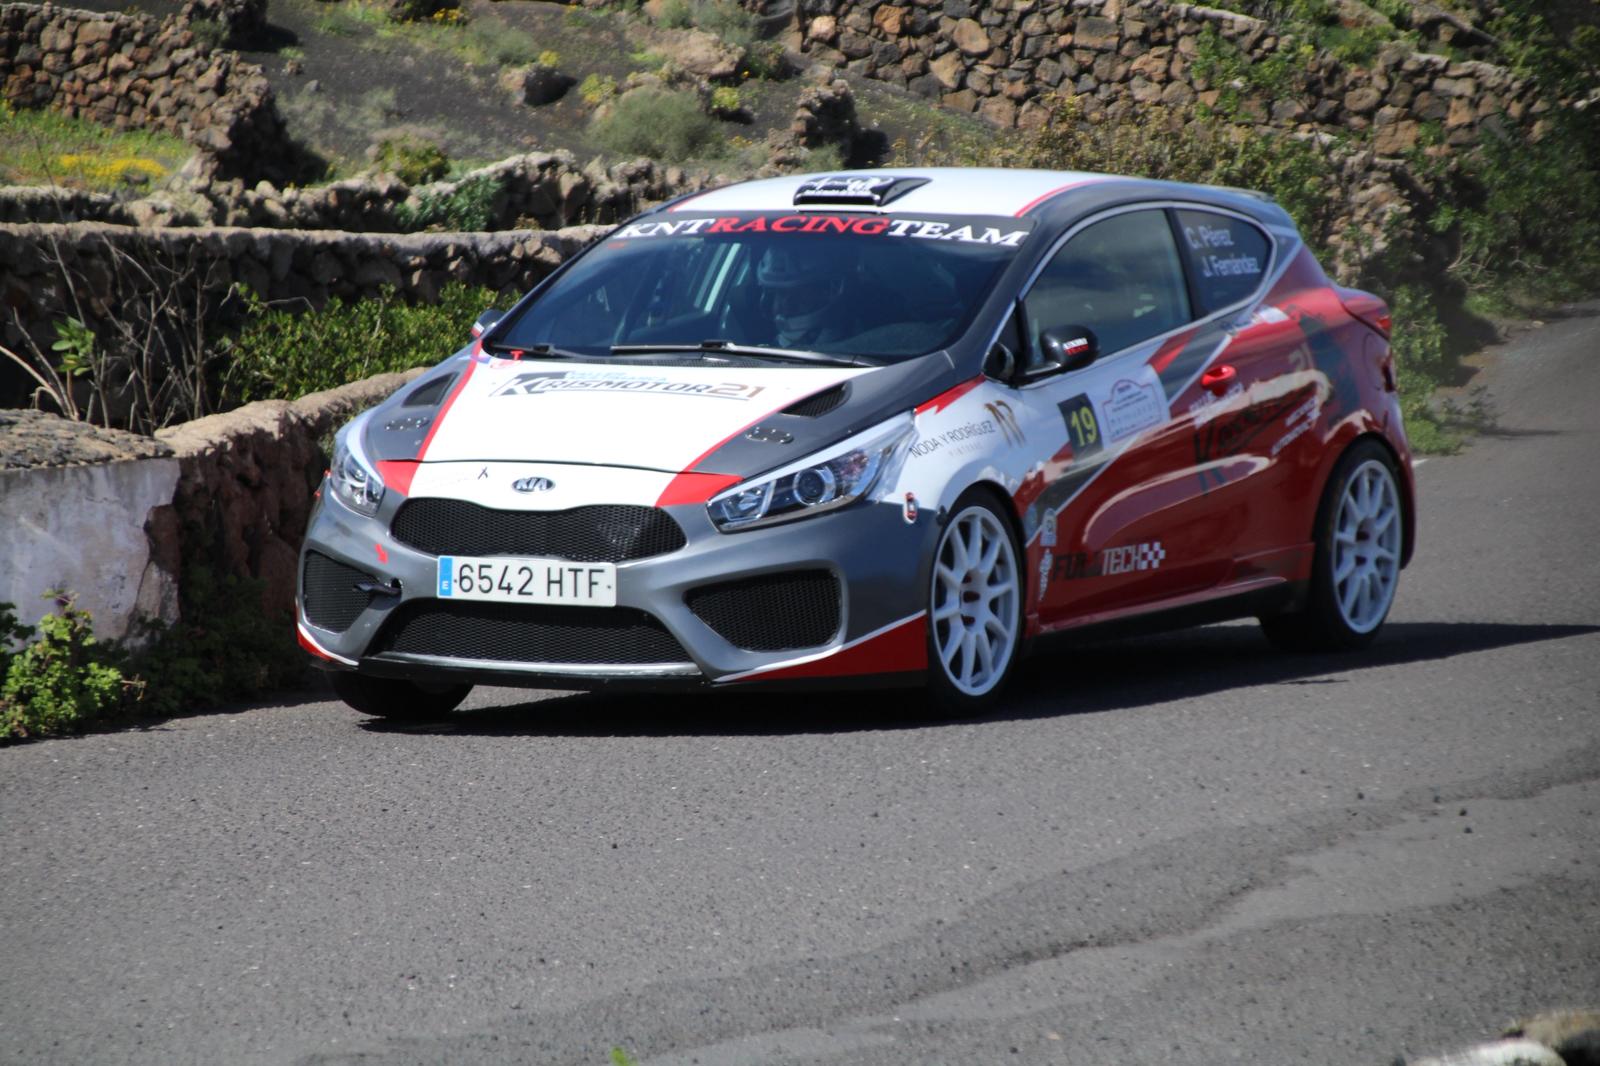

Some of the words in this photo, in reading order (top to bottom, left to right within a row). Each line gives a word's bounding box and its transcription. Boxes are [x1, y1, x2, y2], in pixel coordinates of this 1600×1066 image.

[1071, 406, 1097, 447] 19
[910, 437, 943, 458] NODA
[939, 434, 950, 444] Y
[442, 581, 448, 589] E
[459, 564, 534, 596] 6542
[547, 567, 605, 598] HTF
